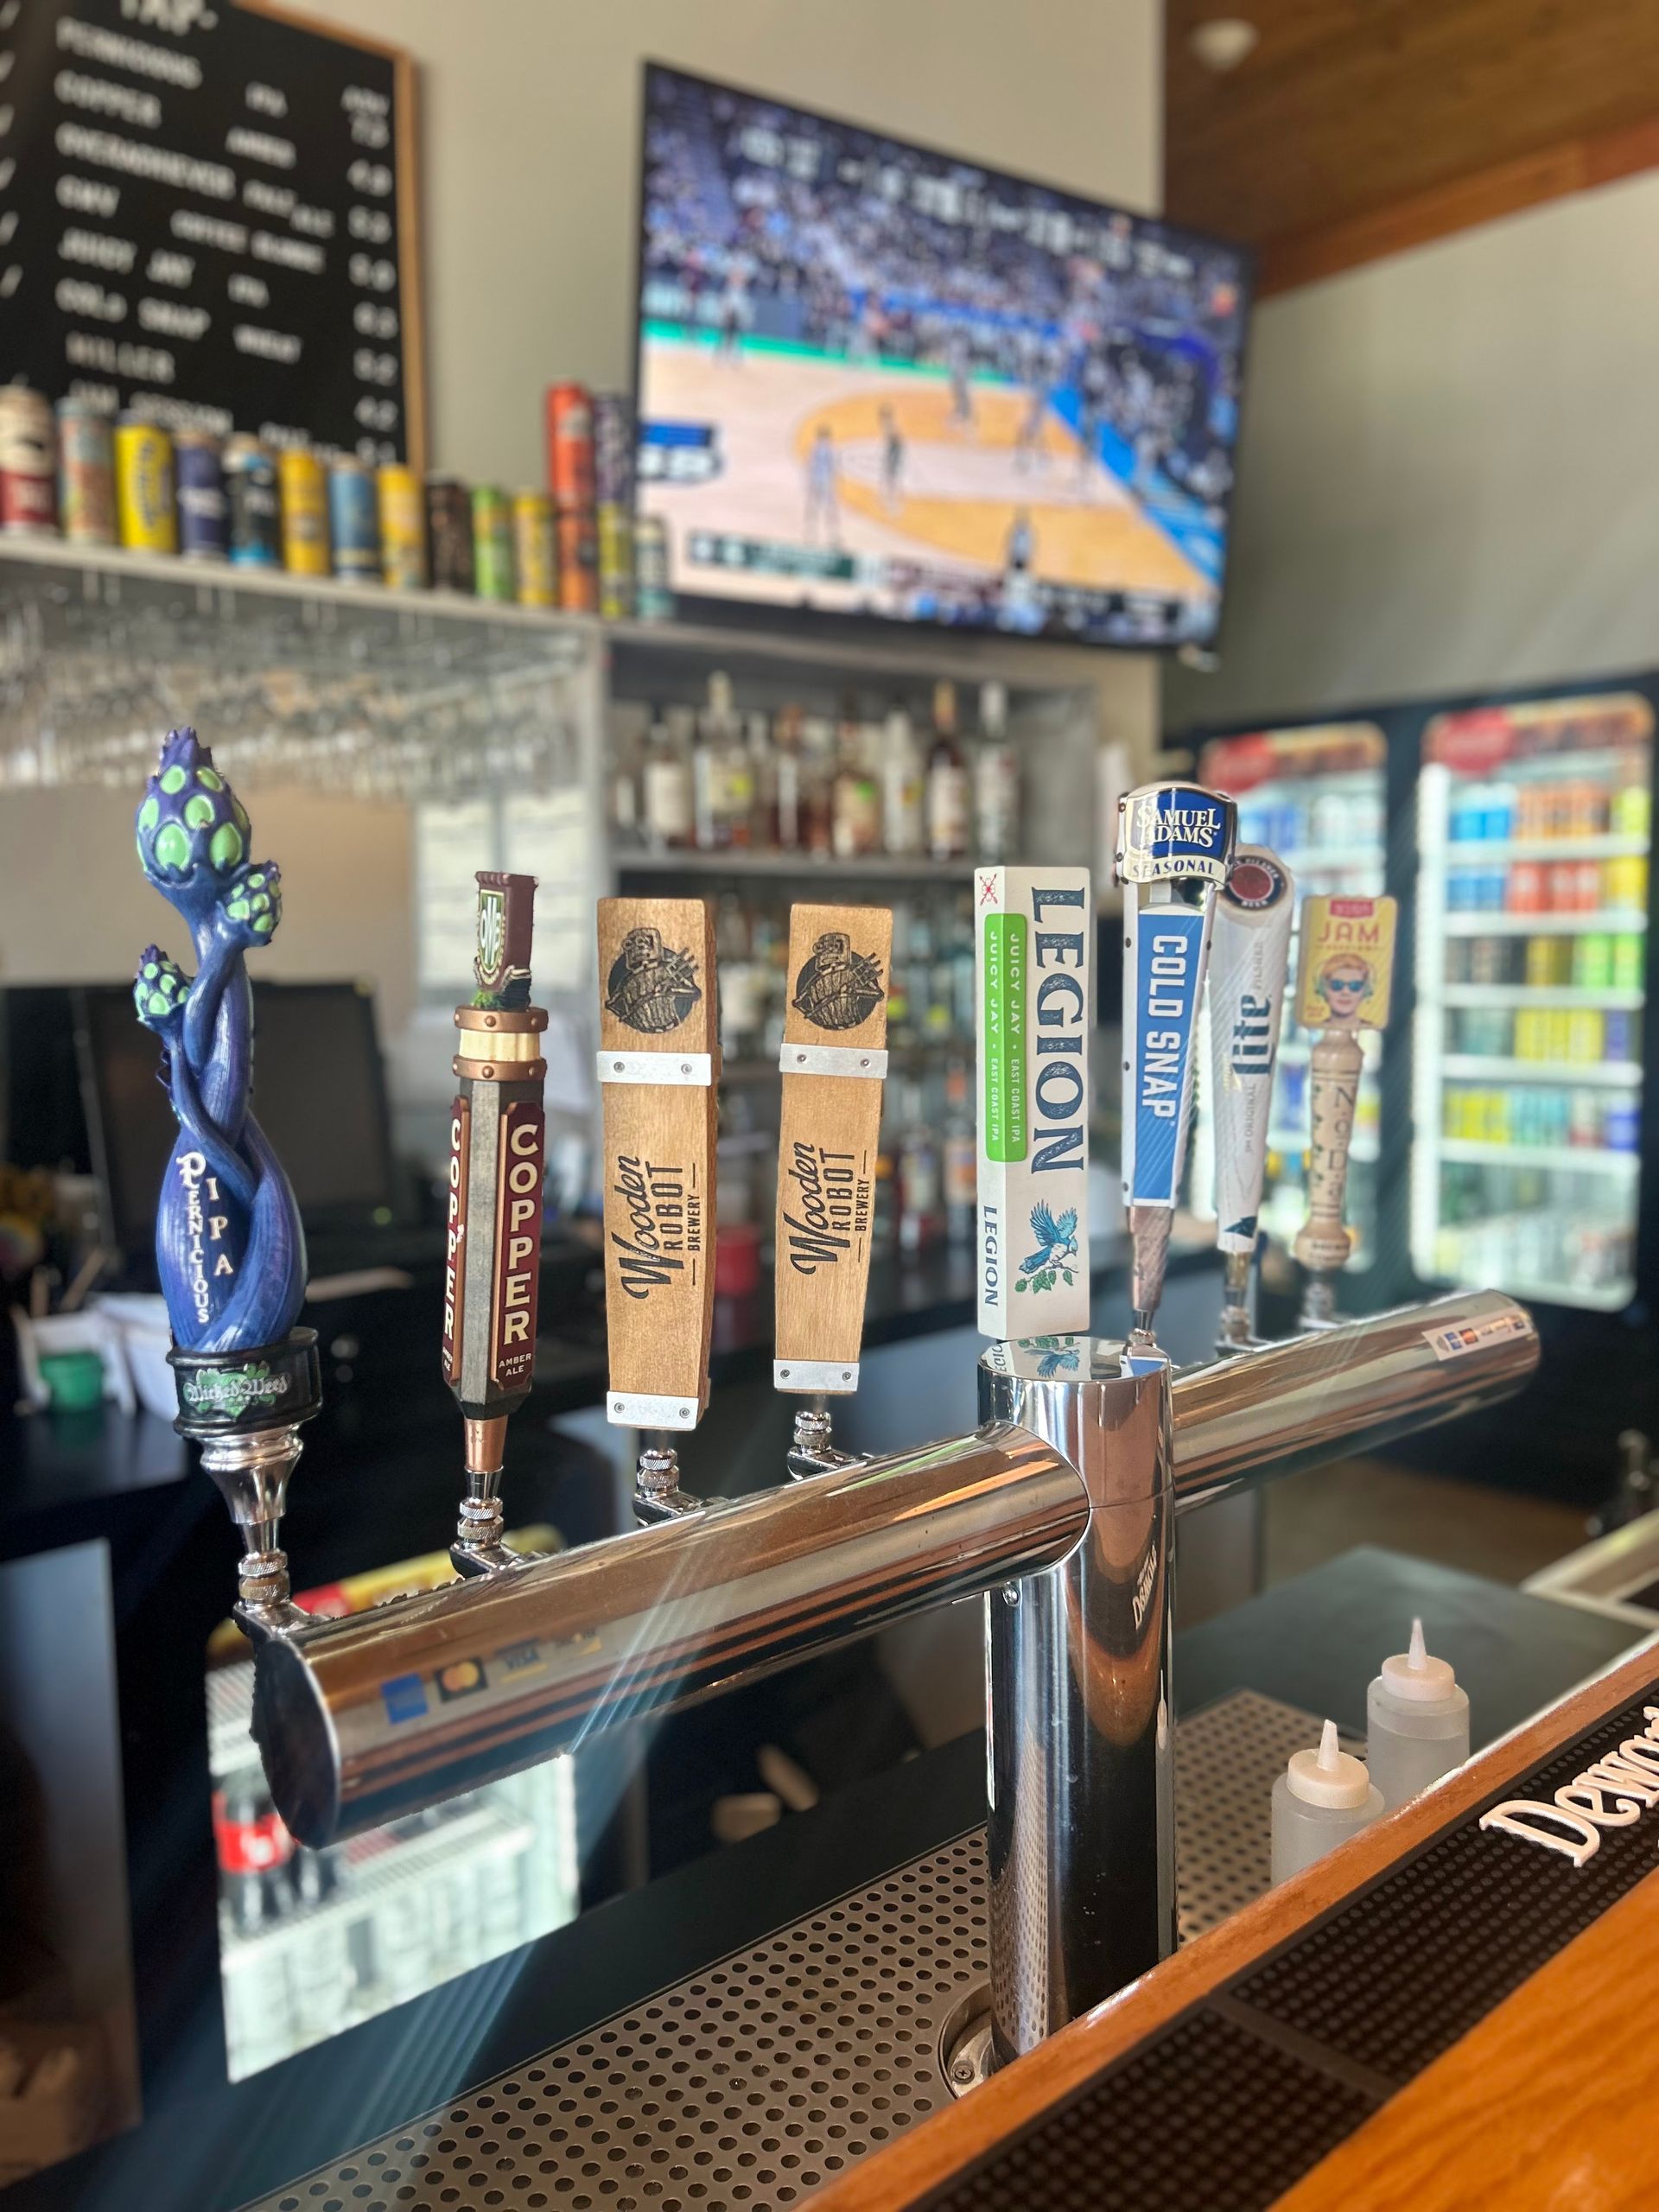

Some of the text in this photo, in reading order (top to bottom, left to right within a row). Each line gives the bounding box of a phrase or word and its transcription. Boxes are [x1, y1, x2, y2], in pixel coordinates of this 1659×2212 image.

[1136, 801, 1221, 830] SAMUEL
[1133, 859, 1217, 878] SEASONAL
[1318, 922, 1379, 942] JAM
[990, 999, 999, 1034] JAY
[1010, 933, 1020, 1142] JUICY JAY EAST COAST IPA
[1031, 887, 1085, 1173] LEGION
[1141, 935, 1188, 1119] COLD SNAP
[206, 1177, 233, 1276] IPA
[444, 1118, 461, 1340] COPPER
[612, 1155, 685, 1299] Wooden
[645, 1161, 683, 1250] ROBOT
[688, 1194, 701, 1251] BREWERY
[785, 1141, 851, 1274] Wooden
[819, 1147, 855, 1231] ROBOT
[855, 1179, 870, 1231] BREWERY
[176, 1152, 209, 1323] PERNICIOUS
[504, 1123, 538, 1345] COPPER
[983, 1205, 998, 1306] LEGION
[189, 1375, 289, 1402] Wicked Weed
[499, 1353, 531, 1368] AMBER
[505, 1364, 524, 1376] ALE
